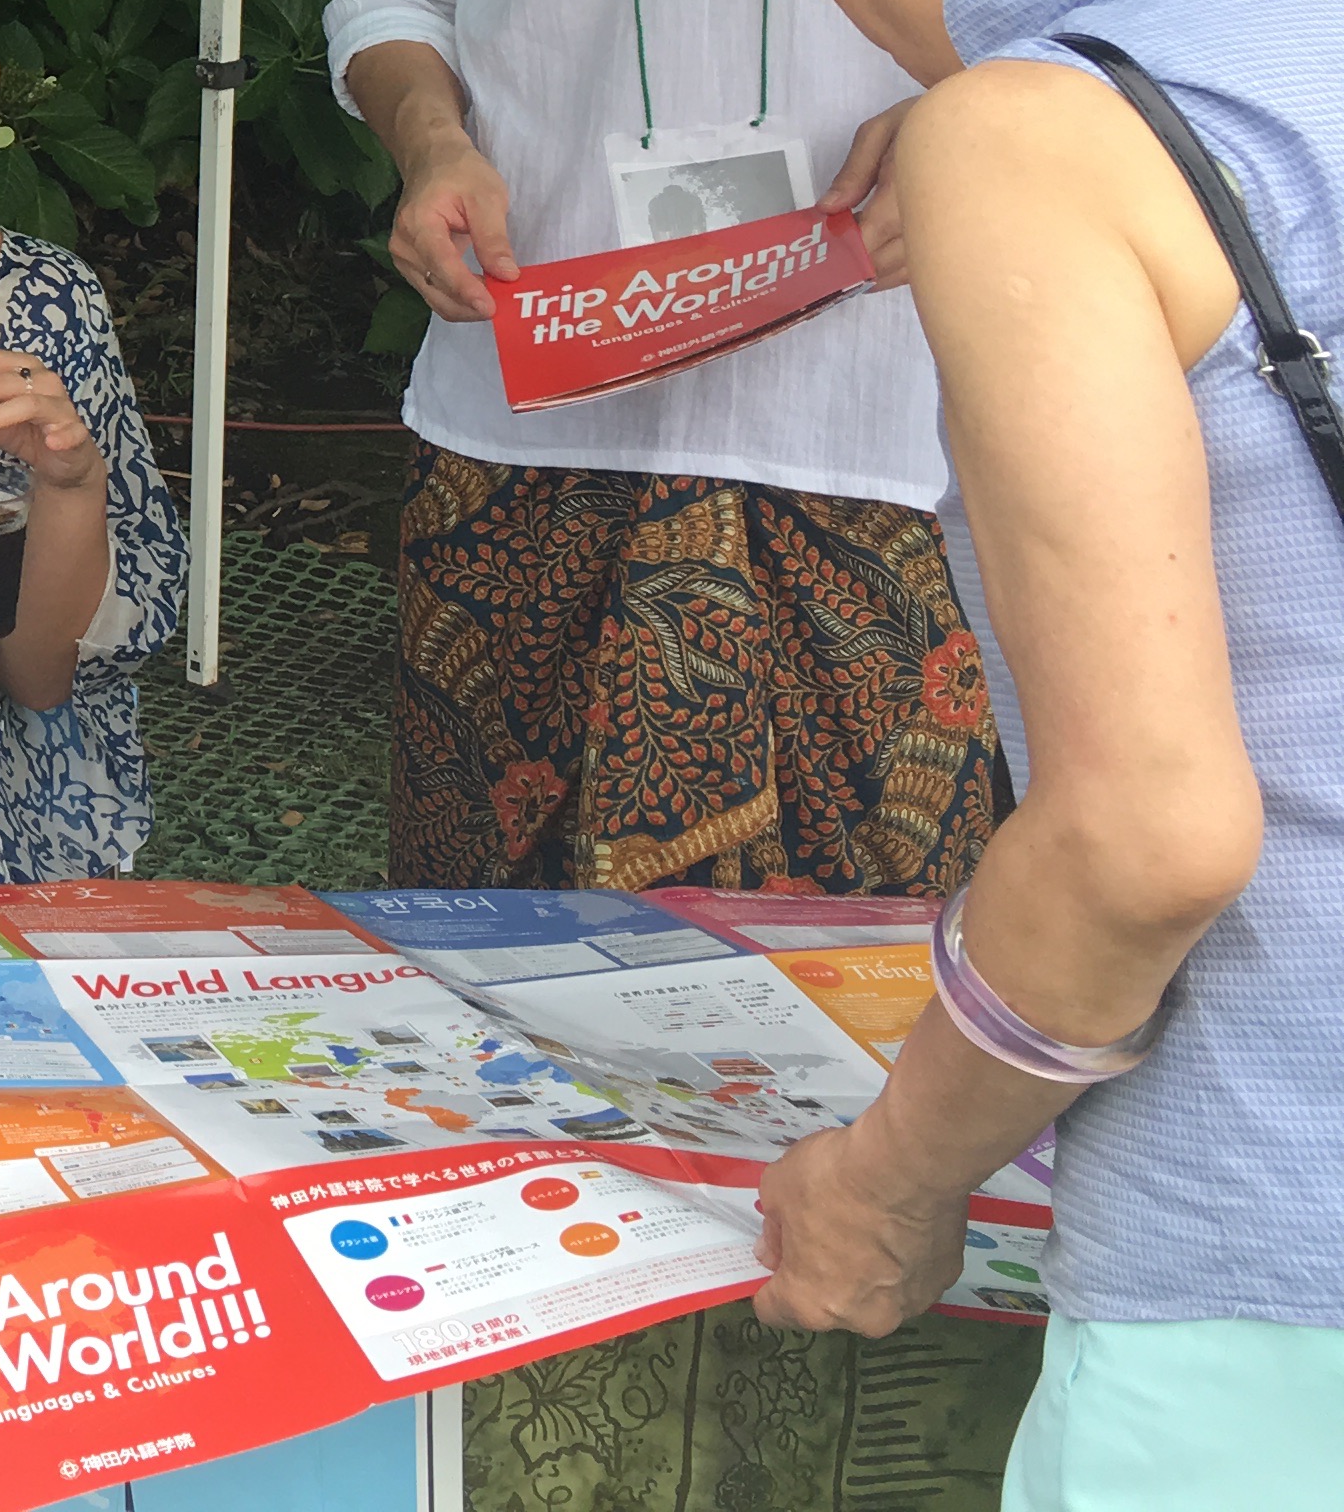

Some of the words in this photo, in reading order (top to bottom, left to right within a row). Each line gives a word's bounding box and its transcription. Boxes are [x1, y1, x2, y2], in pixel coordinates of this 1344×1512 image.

[514, 285, 607, 320] Trip
[618, 221, 824, 301] Around
[531, 317, 602, 345] the
[612, 242, 829, 328] World!!!
[591, 318, 684, 348] Languages
[690, 310, 704, 322] &
[709, 286, 778, 316] Cultures
[28, 887, 113, 904] 中文
[369, 894, 499, 915] 한국어
[72, 969, 230, 1001] World
[102, 1382, 121, 1399] &
[127, 1362, 217, 1394] Cultures
[79, 1432, 197, 1475] 神田外語学院
